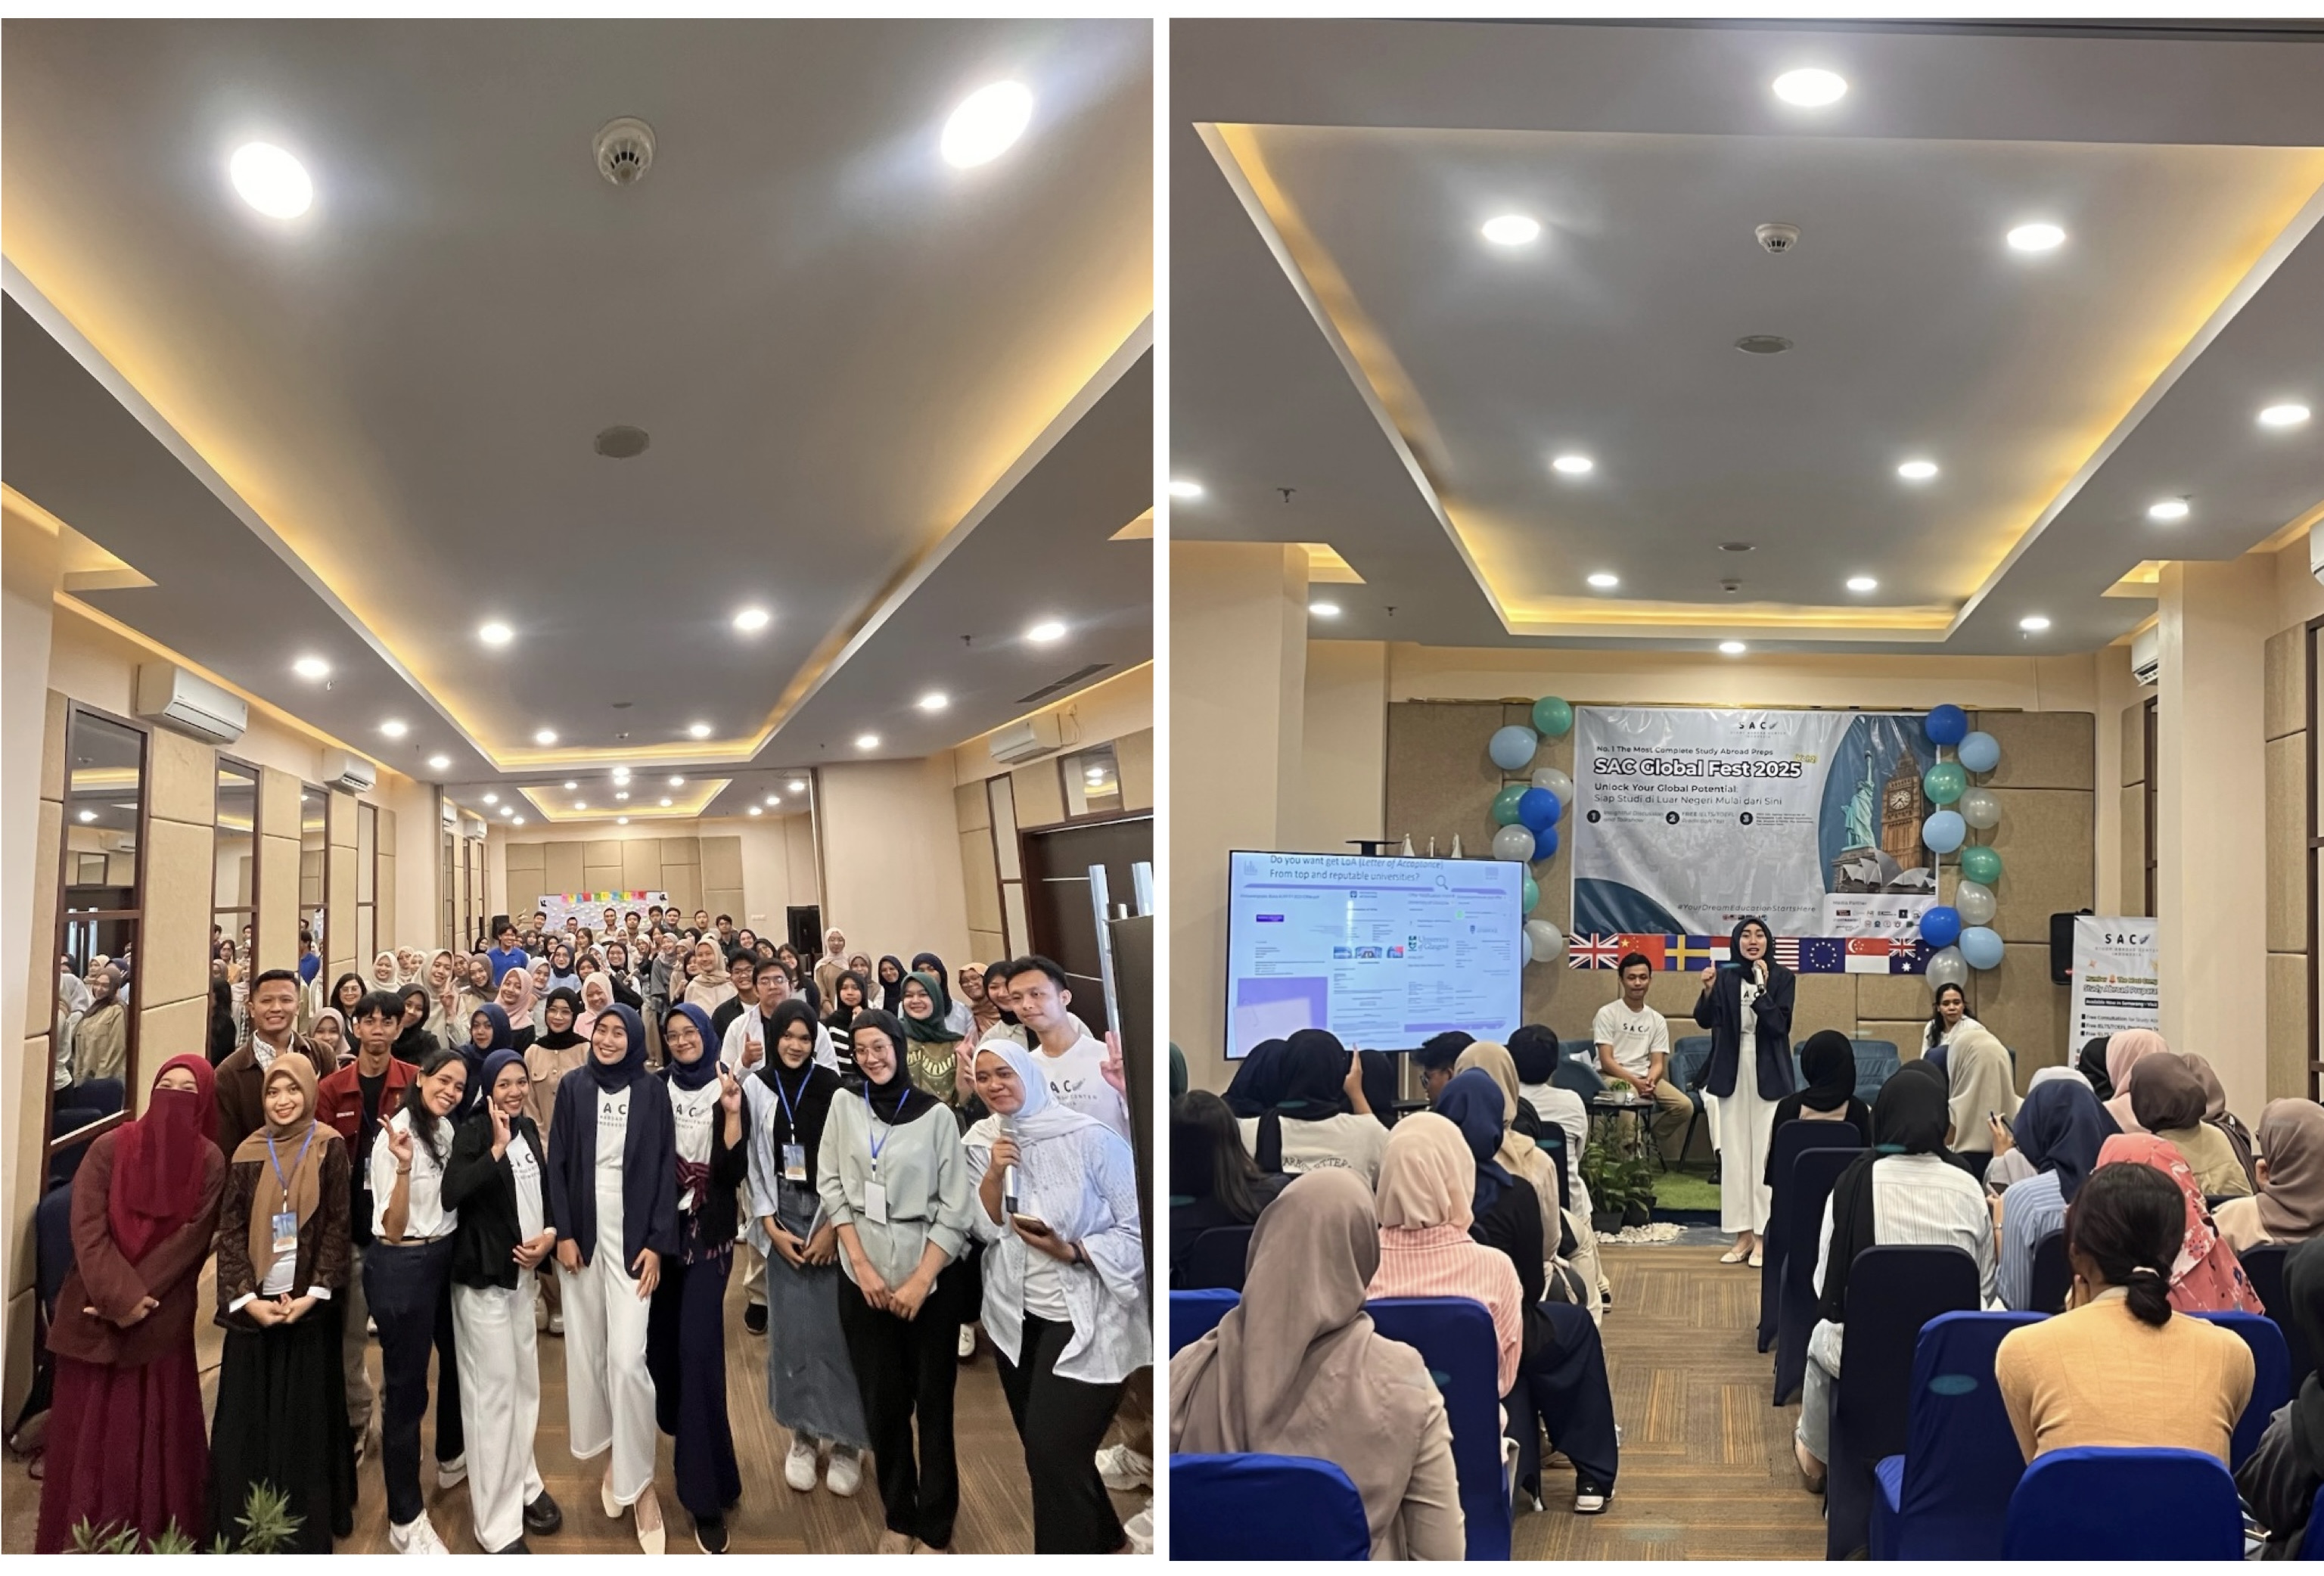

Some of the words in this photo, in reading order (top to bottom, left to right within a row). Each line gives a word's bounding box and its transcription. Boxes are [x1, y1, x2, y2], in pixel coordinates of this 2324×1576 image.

[1594, 757, 1636, 775] SAC
[1640, 757, 1704, 776] Global
[1708, 760, 1751, 777] Fest
[1753, 761, 1802, 779] 2025
[1633, 783, 1654, 791] Your
[1658, 784, 1689, 792] Global
[1595, 794, 1615, 804] Siap
[1617, 794, 1643, 803] Studi
[1656, 795, 1678, 804] Luar
[1681, 796, 1713, 806] Negeri
[1716, 797, 1741, 805] Mulai
[1743, 797, 1762, 805] dari
[1765, 797, 1782, 806] Sini
[1270, 855, 1282, 864] Do
[1285, 856, 1301, 867] you
[1303, 856, 1324, 866] want
[1326, 858, 1339, 867] get
[1341, 858, 1357, 866] LoA
[1270, 869, 1293, 878] From
[1294, 870, 1310, 880] top
[1311, 870, 1328, 879] and
[1329, 871, 1369, 881] reputable
[1371, 872, 1421, 882] universities?
[2105, 933, 2137, 945] SAC
[2083, 984, 2104, 994] Study
[2104, 984, 2130, 993] Abroad
[1622, 1023, 1643, 1033] SAC
